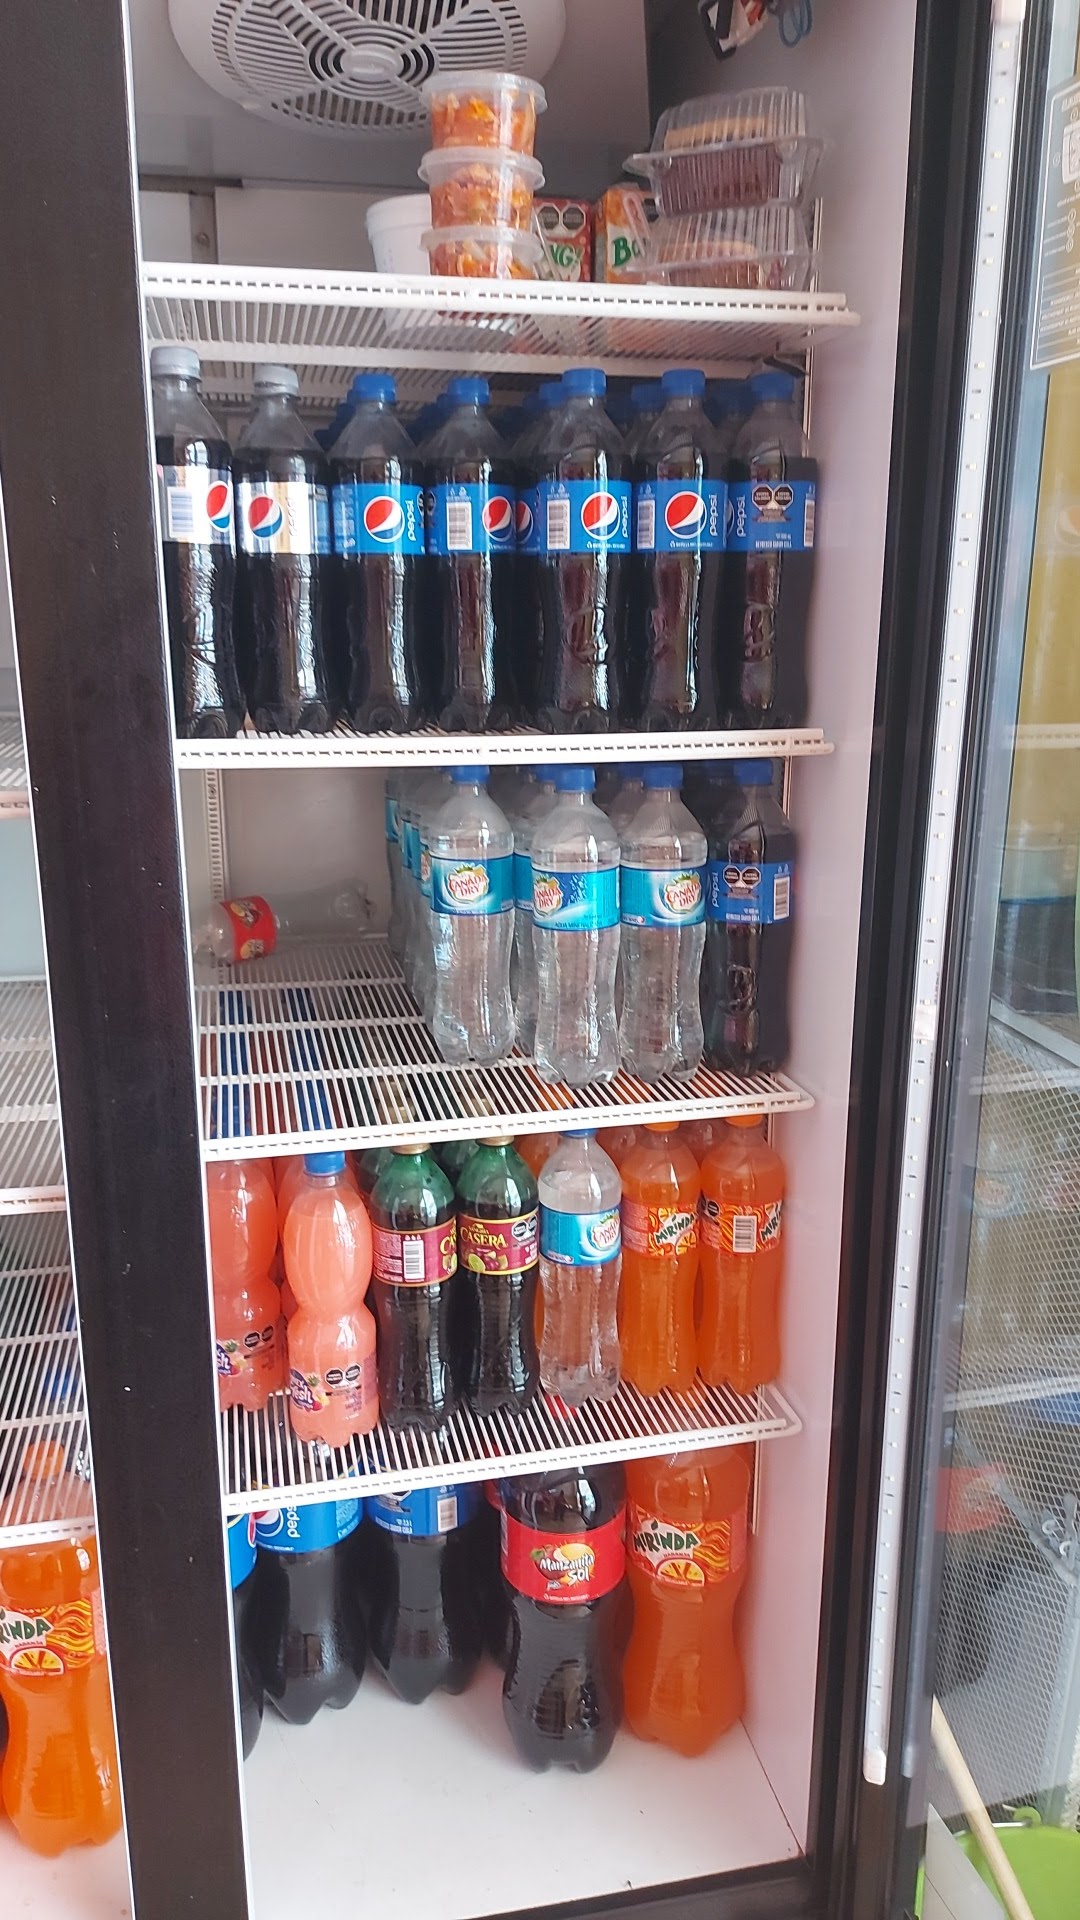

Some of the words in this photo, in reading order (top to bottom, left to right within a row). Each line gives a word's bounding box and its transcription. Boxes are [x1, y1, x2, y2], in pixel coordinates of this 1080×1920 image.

[405, 498, 416, 542] pepsi
[620, 495, 629, 539] pepsi
[708, 493, 719, 537] pepsi
[736, 494, 747, 538] pepsi
[448, 872, 488, 894] CANADA
[460, 883, 480, 897] DRY
[533, 886, 563, 900] ANADA
[711, 871, 720, 908] pepsi
[539, 895, 554, 908] DRY
[680, 892, 694, 907] DRY
[460, 1226, 509, 1251] CASERA
[655, 1212, 696, 1244] MIRINDA
[286, 1505, 301, 1539] peps
[633, 1519, 699, 1553] MIRINDA
[540, 1552, 595, 1572] Manzanita
